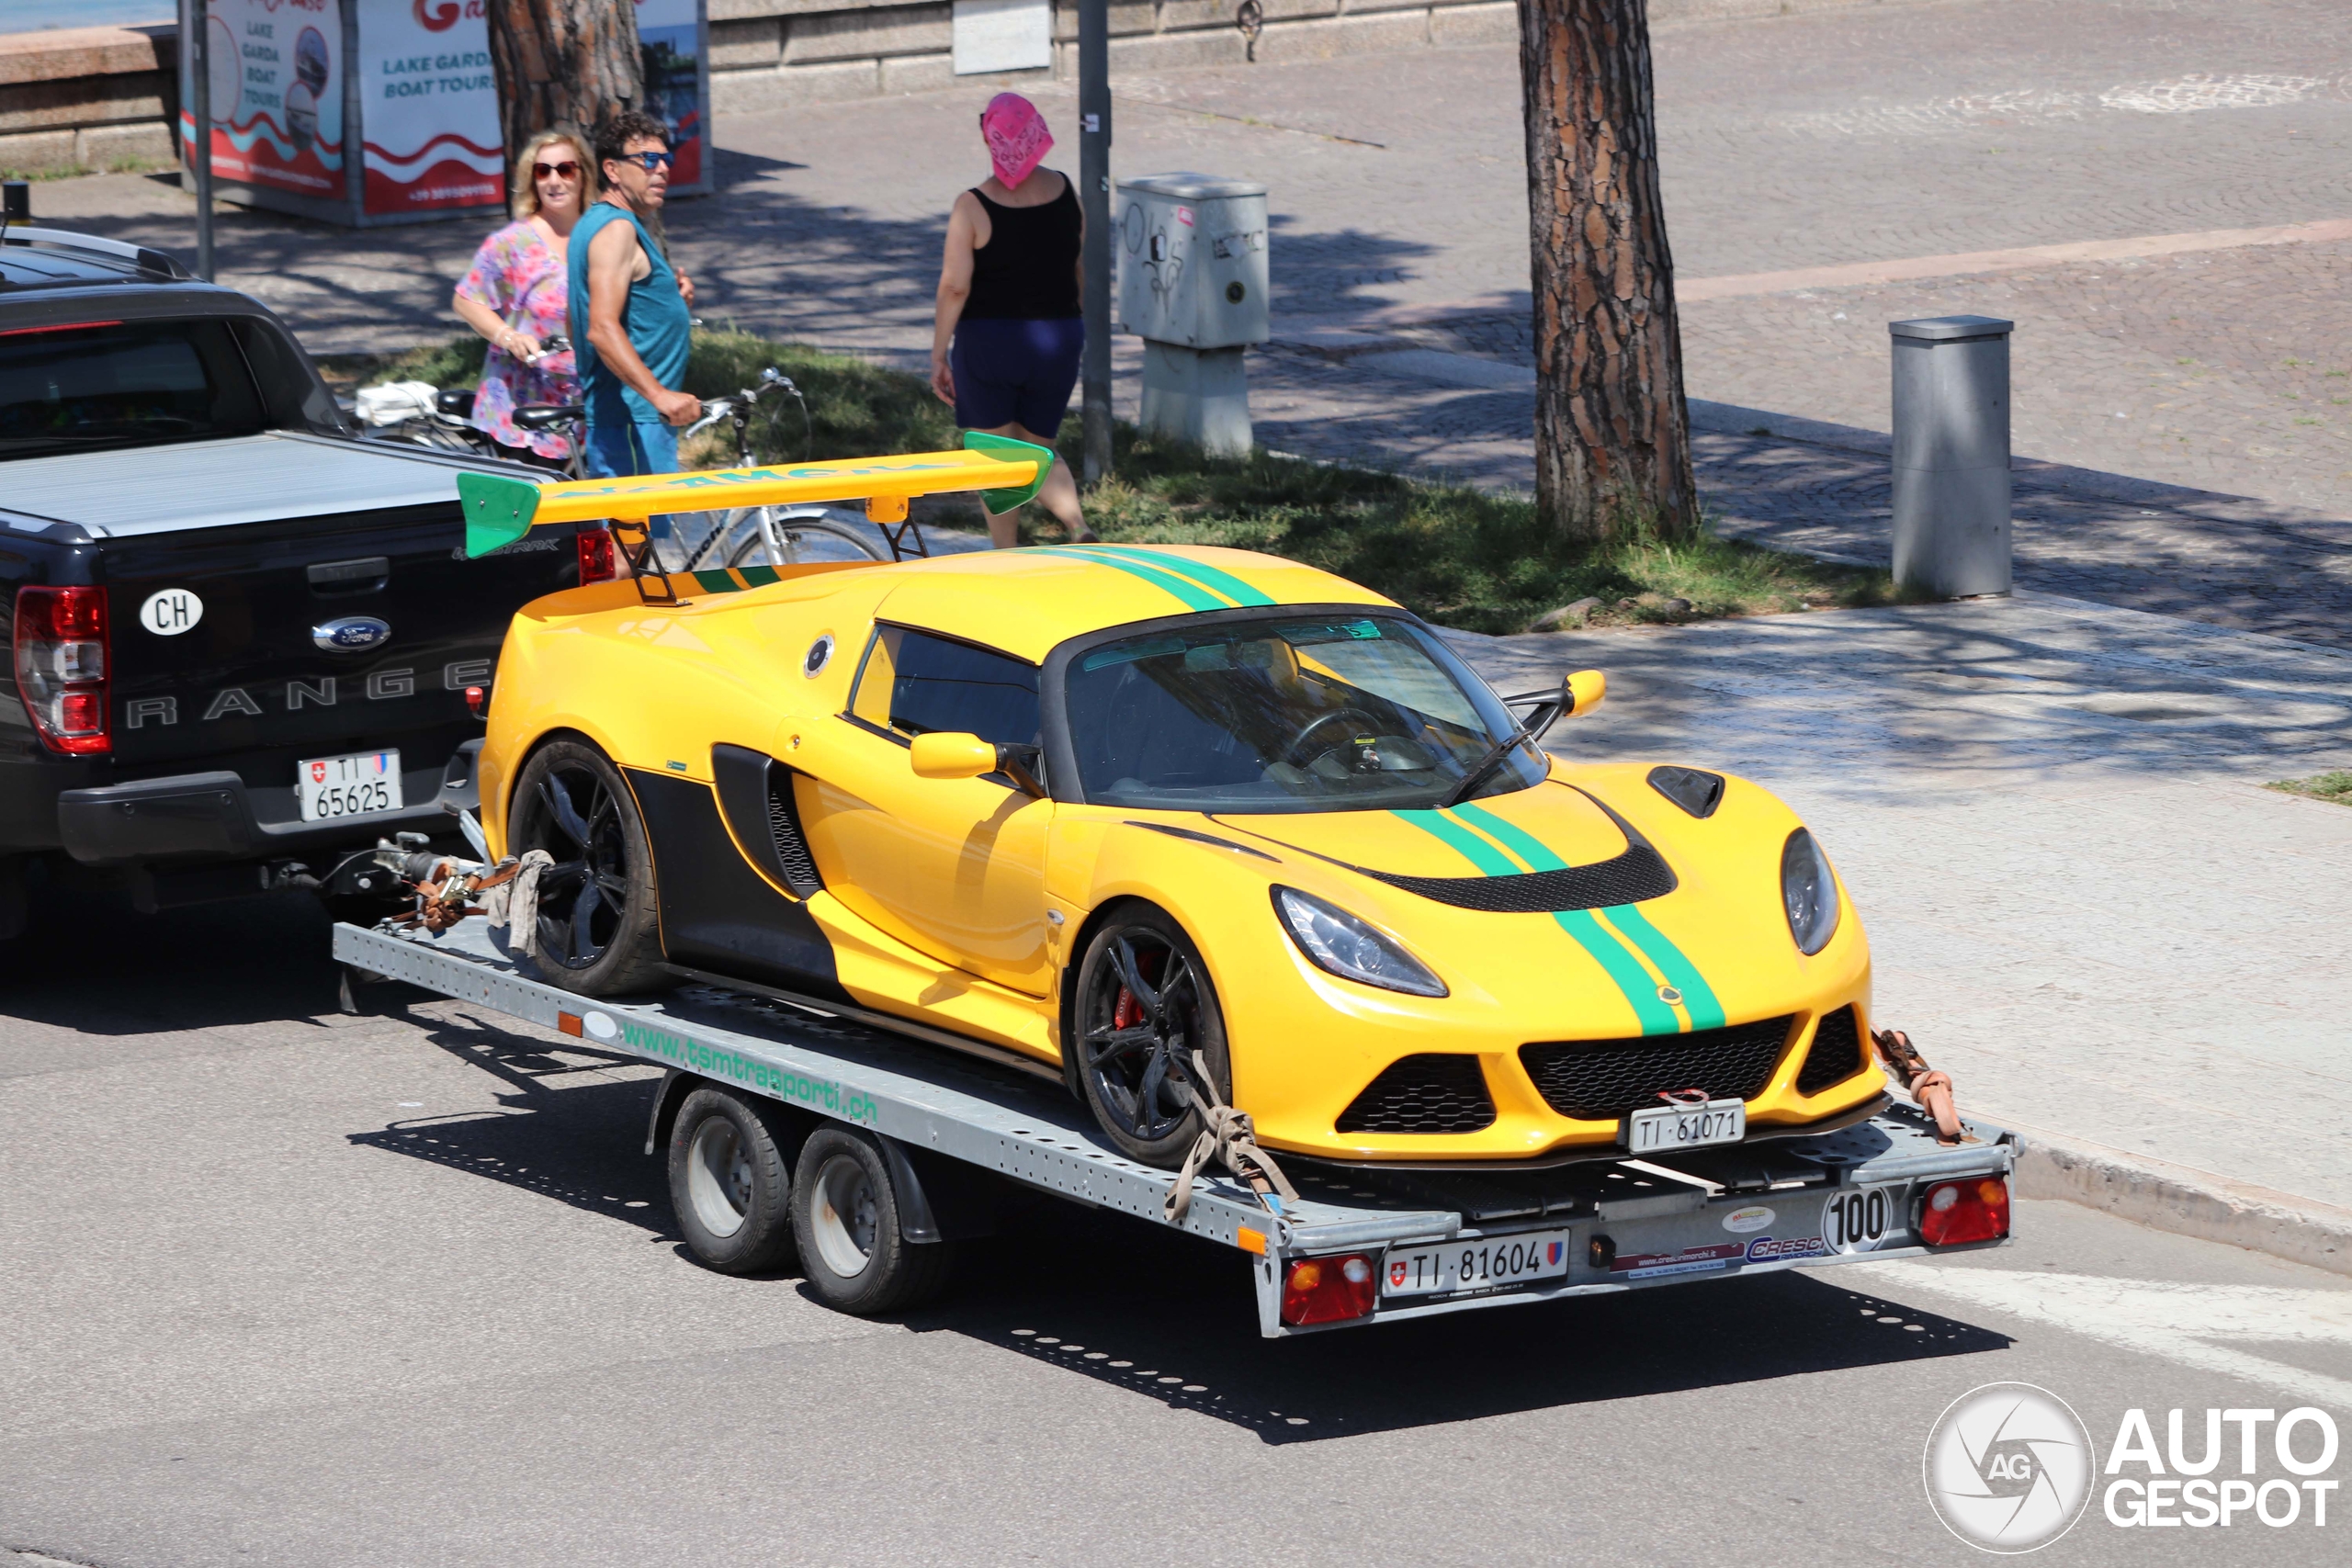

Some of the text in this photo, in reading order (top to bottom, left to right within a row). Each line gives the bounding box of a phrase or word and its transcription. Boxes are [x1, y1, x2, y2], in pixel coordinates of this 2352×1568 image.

[246, 21, 274, 39] LAKE
[242, 43, 280, 62] GARDA
[382, 52, 492, 74] LAKE GARD
[246, 65, 277, 85] BOAT
[244, 89, 281, 109] TOURS
[384, 80, 434, 98] BOAT
[155, 594, 189, 629] CH
[127, 658, 492, 729] RANGE
[338, 756, 358, 781] TI
[317, 781, 390, 818] 65625
[621, 1022, 878, 1125] www.tsmtrasporti.ch
[1830, 1190, 1883, 1247] 100
